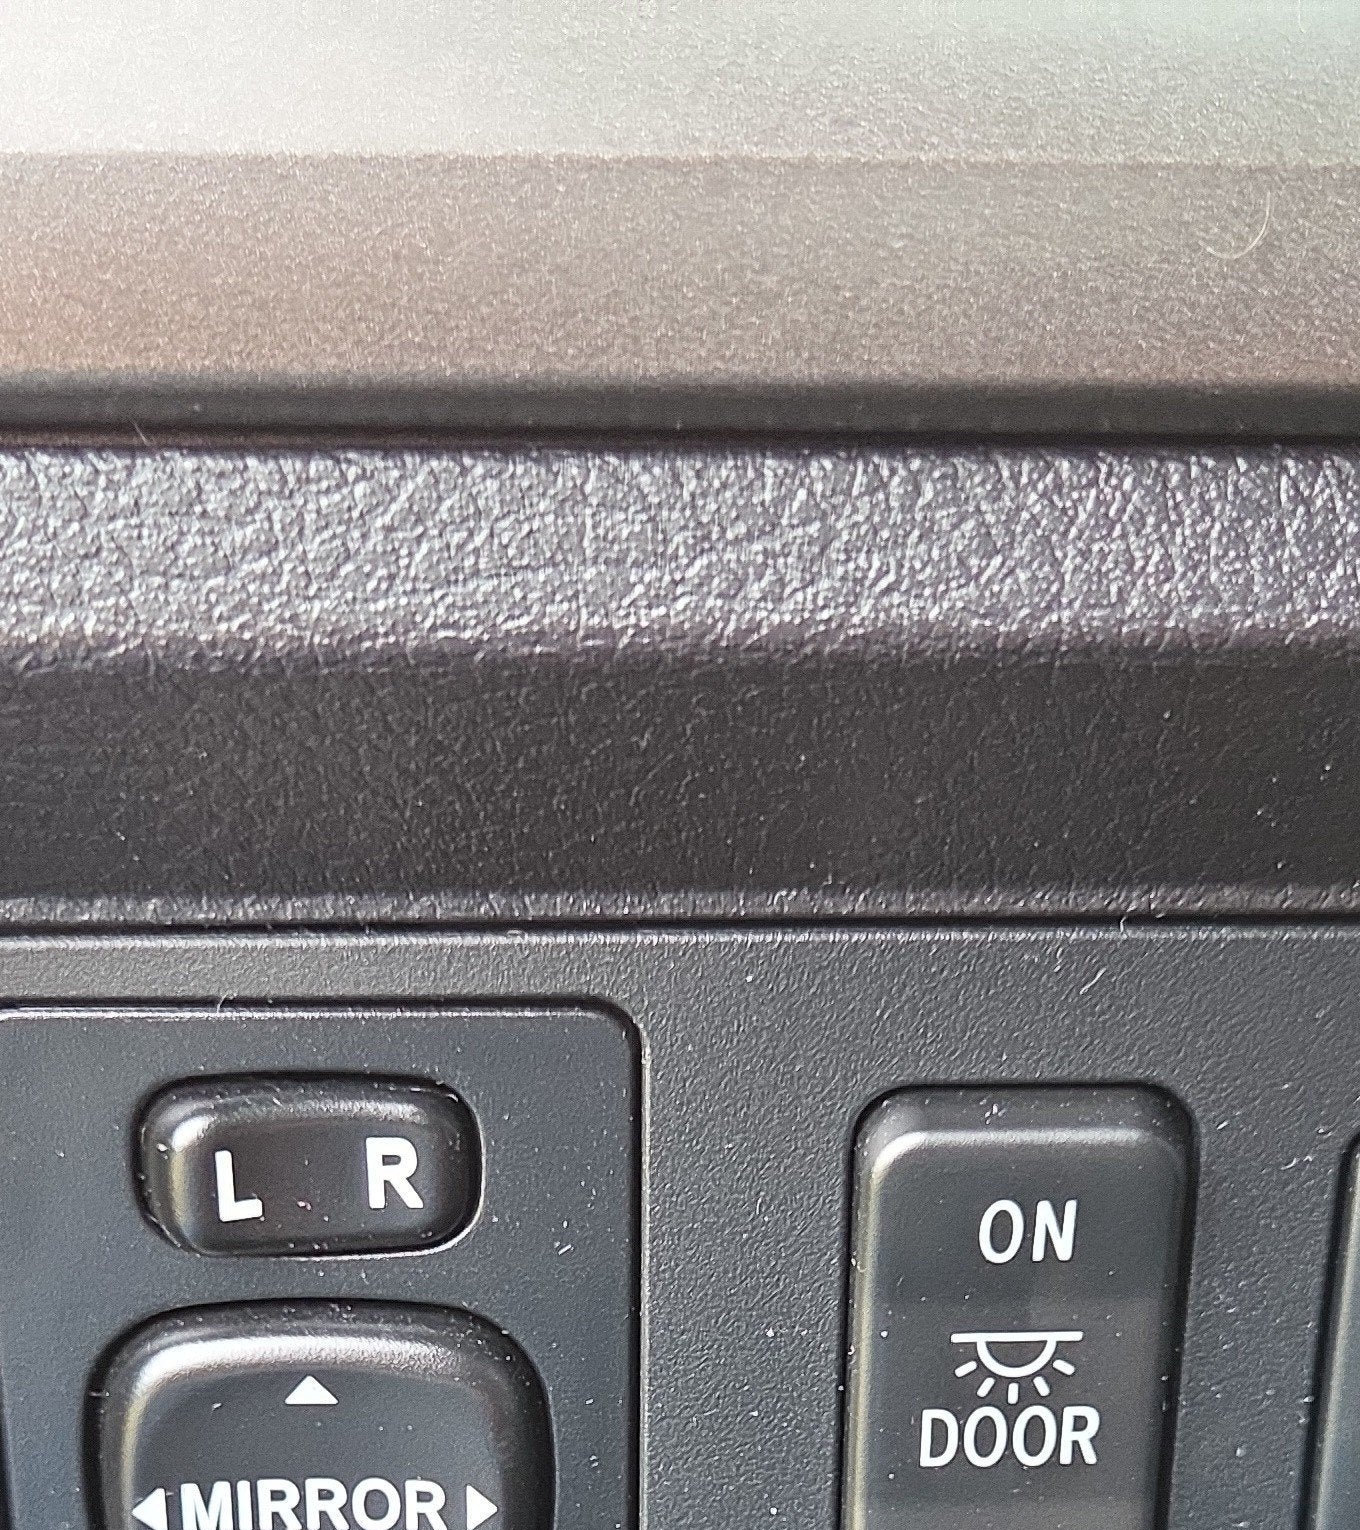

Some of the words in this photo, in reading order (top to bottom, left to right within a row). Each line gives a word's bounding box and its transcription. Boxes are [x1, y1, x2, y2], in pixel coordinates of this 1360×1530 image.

[215, 1149, 264, 1223] L
[365, 1136, 425, 1210] R
[978, 1199, 1078, 1264] ON
[919, 1404, 1100, 1468] DOOR
